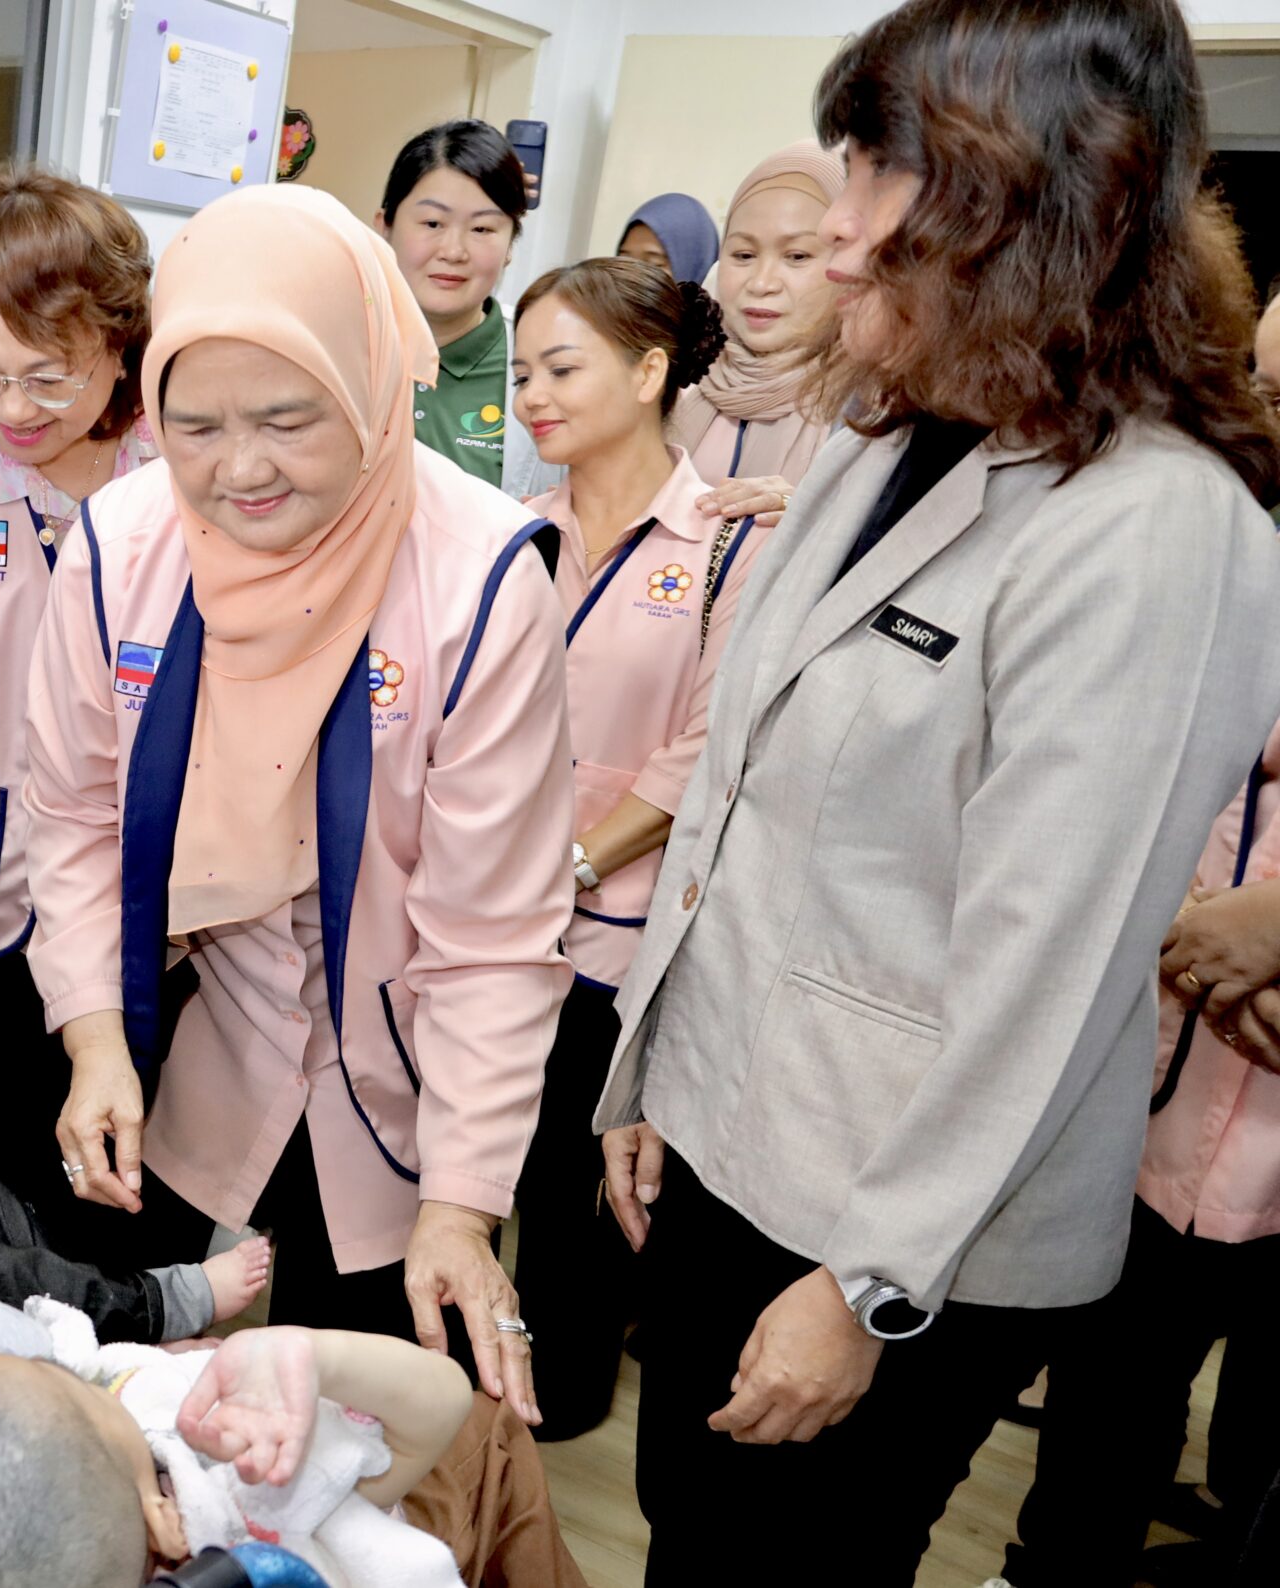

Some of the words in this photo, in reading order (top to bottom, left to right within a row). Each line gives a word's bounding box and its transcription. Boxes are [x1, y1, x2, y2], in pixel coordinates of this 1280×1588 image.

[455, 437, 487, 448] AZAM
[487, 442, 505, 450] JA
[632, 600, 670, 612] MUTIARA
[672, 607, 691, 616] GRS
[647, 610, 672, 619] SABAH
[121, 681, 141, 693] SA
[125, 699, 145, 711] JU
[387, 712, 409, 721] GRS
